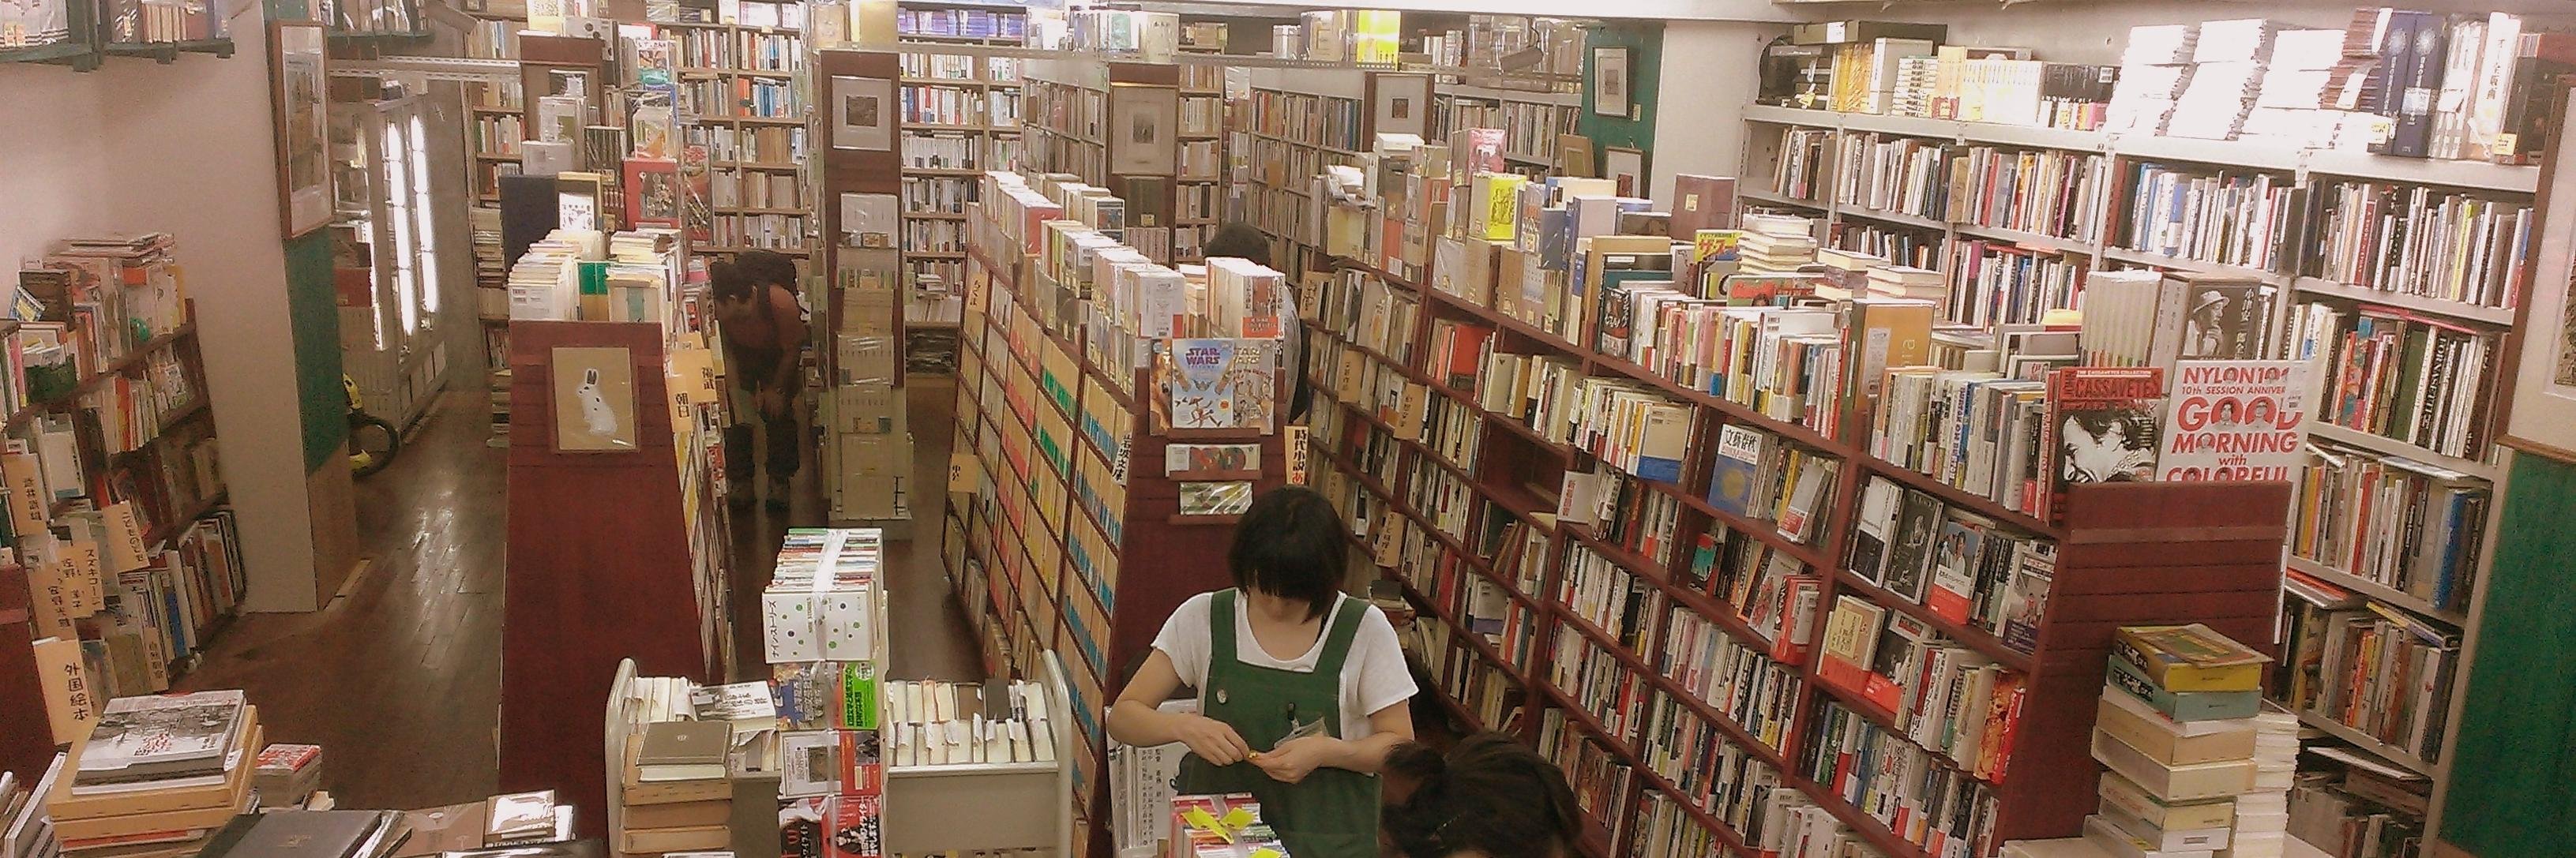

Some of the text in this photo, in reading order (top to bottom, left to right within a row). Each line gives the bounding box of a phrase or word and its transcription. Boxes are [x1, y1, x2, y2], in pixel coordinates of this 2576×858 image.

[1185, 347, 1220, 356] STAR
[1186, 356, 1221, 365] WARS
[2075, 379, 2161, 398] CASSAVETES
[2181, 385, 2202, 395] 10th
[2206, 385, 2244, 395] SESSION
[2176, 396, 2304, 432] GOOD
[2171, 432, 2299, 454] MORNING
[1112, 434, 1132, 481] 岩波文庫
[2218, 454, 2247, 466] with
[768, 600, 779, 658] ナイン・ストーリーズ
[64, 661, 89, 721] 外国絵本
